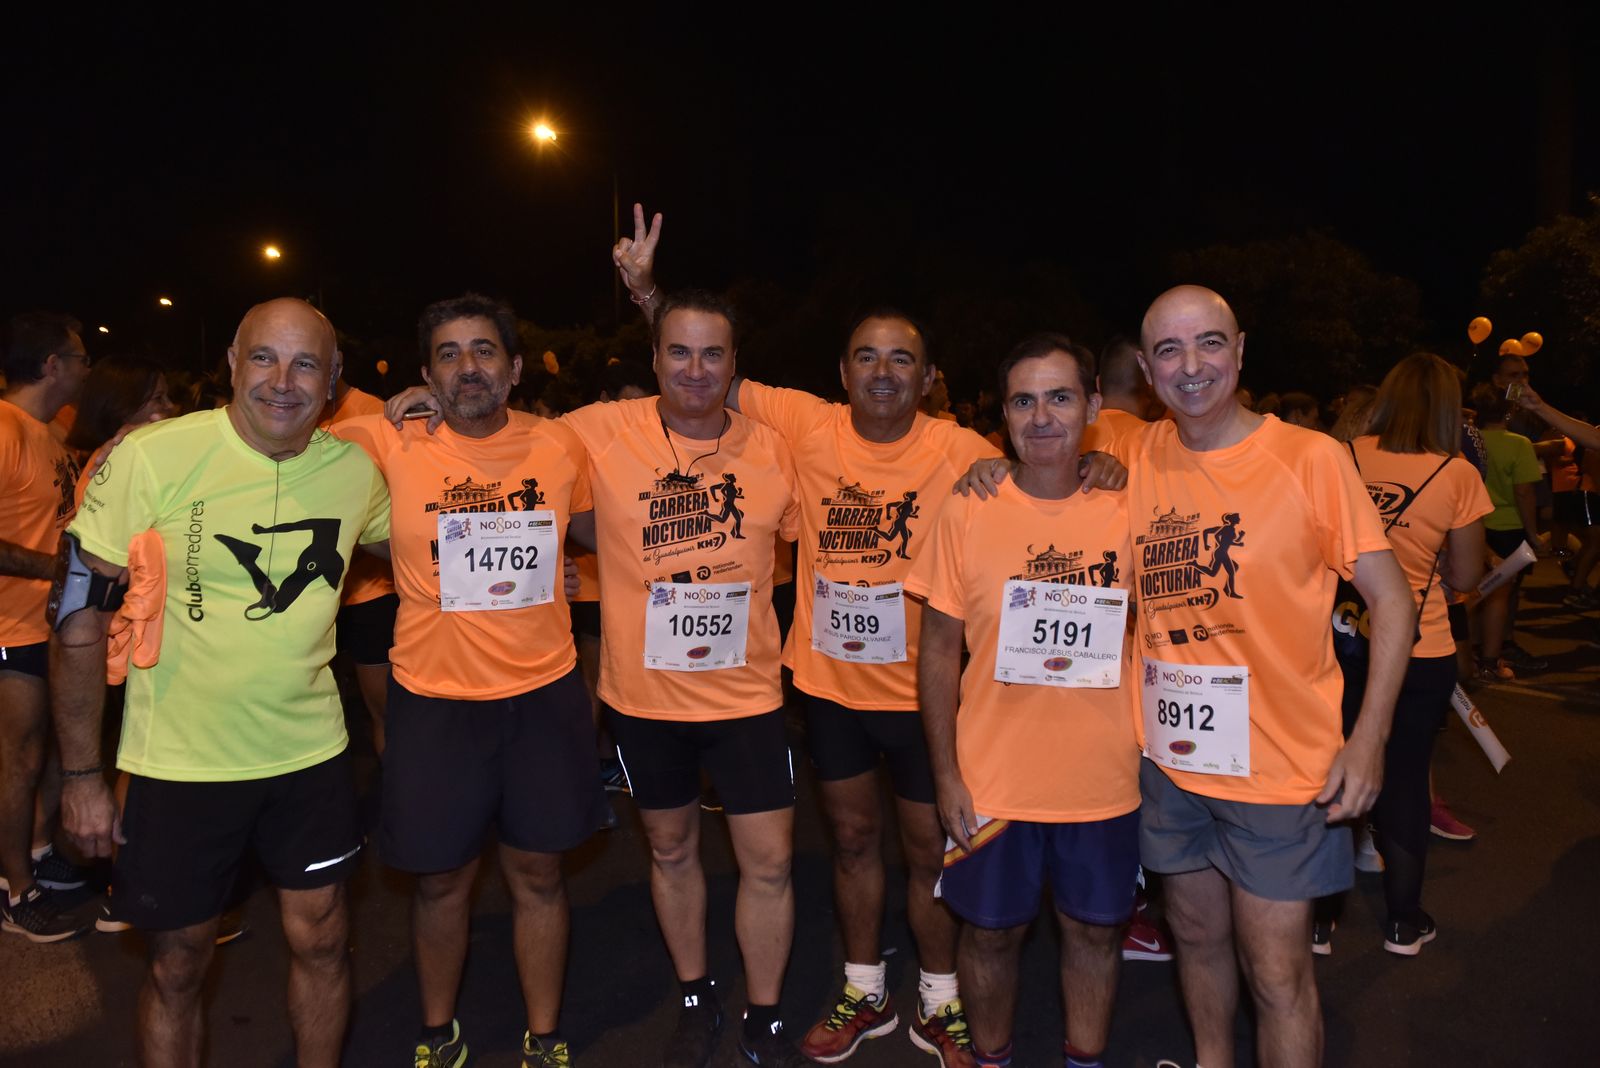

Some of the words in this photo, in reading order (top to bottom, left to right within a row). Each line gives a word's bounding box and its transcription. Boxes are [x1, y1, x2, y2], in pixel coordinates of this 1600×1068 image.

[649, 491, 710, 520] CARRERA
[826, 507, 883, 526] CARRERA
[642, 514, 712, 548] NOCTURNA
[818, 530, 879, 550] NOCTURNA
[464, 545, 539, 573] 14762
[652, 545, 696, 565] Guadalquivir
[1143, 535, 1200, 569] CARRERA
[669, 613, 733, 637] 10552
[830, 609, 880, 635] 5189
[1032, 618, 1093, 648] 5191
[839, 633, 862, 641] PARDO
[1004, 646, 1047, 655] FRANCISCO
[1047, 648, 1073, 657] JESUS
[1073, 650, 1118, 661] CABALLERO
[1157, 698, 1215, 732] 8912
